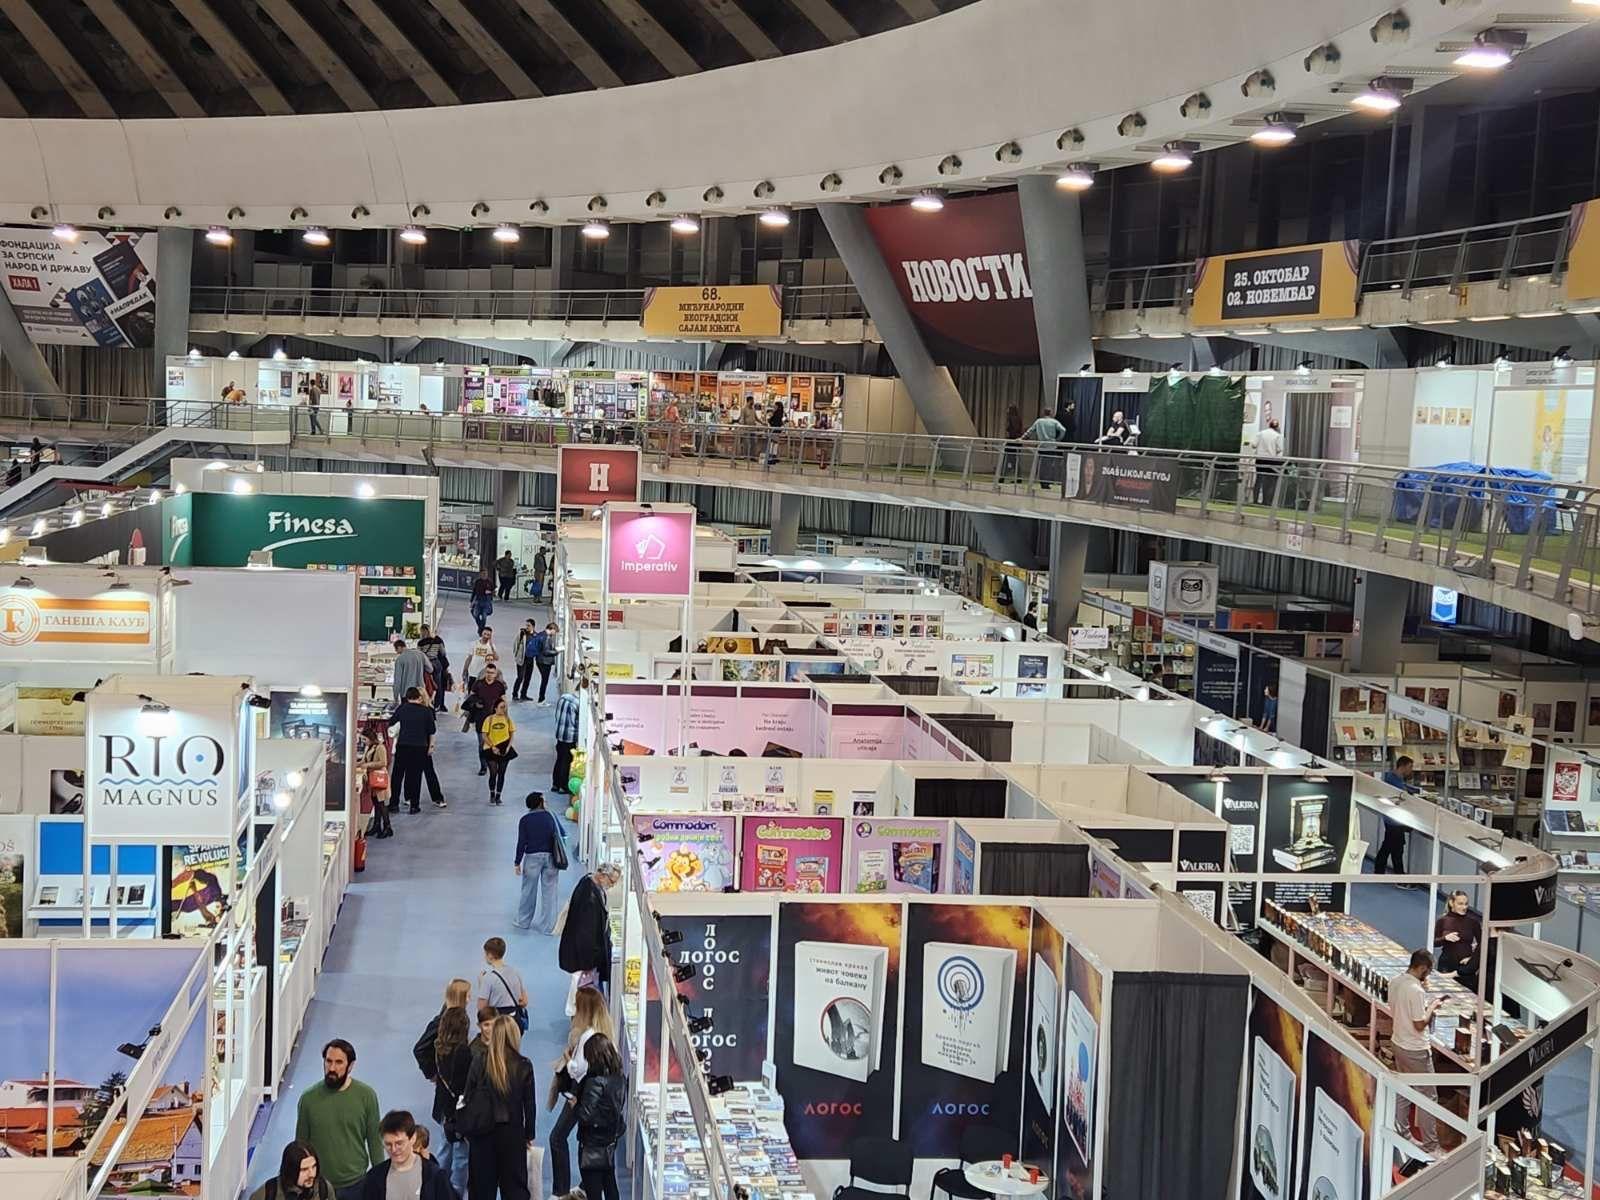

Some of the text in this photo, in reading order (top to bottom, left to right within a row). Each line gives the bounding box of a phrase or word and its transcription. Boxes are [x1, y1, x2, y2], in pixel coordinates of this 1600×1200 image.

[1, 250, 55, 261] ЗА СРПСКИ
[4, 262, 39, 272] НАРОД
[50, 264, 92, 273] ДРЖАВУ
[902, 253, 1033, 302] НОВОСТИ
[1234, 266, 1310, 287] 25. ОКТОБАР
[702, 288, 721, 300] 68.
[1227, 285, 1315, 306] 02. НОВЕМБАР
[684, 313, 738, 322] БЕОГРАДСКИ
[679, 324, 741, 332] САЈАМ КЊИГА
[268, 511, 354, 534] Finesa
[621, 559, 678, 573] Imperativ
[44, 616, 145, 627] ГАНЕША КЛУБ
[98, 735, 224, 777] RIO
[102, 788, 218, 806] MAGNUS
[679, 950, 740, 964] ЛОГОС
[804, 1103, 863, 1116] ЛОГОС
[932, 1103, 990, 1116] ЛОГОС
